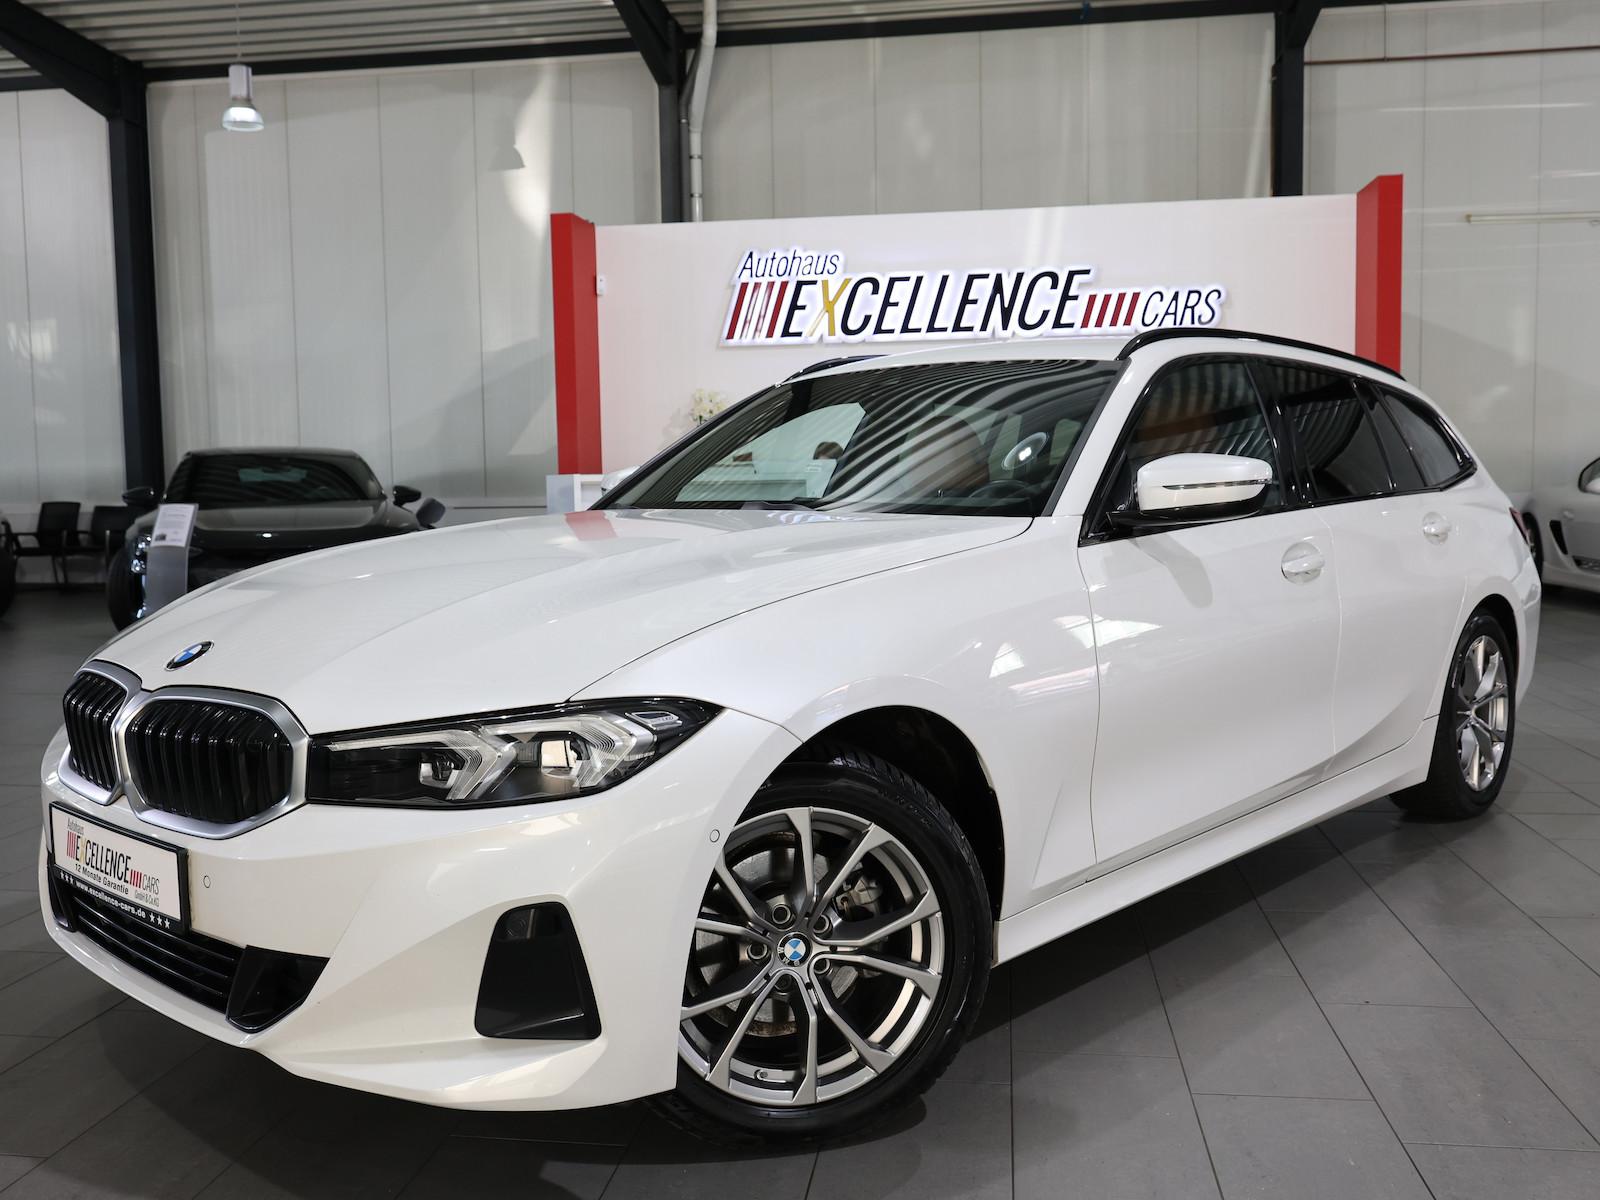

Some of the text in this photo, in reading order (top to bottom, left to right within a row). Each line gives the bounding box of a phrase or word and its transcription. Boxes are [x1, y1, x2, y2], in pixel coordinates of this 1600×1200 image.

[738, 249, 840, 279] Autohaus
[780, 269, 1222, 338] EXCELLENCE CARS
[75, 835, 160, 895] EXCELLENCE CARS
[75, 863, 129, 895] 12 Monate Garantie
[76, 880, 146, 919] www.excellence-cars.de
